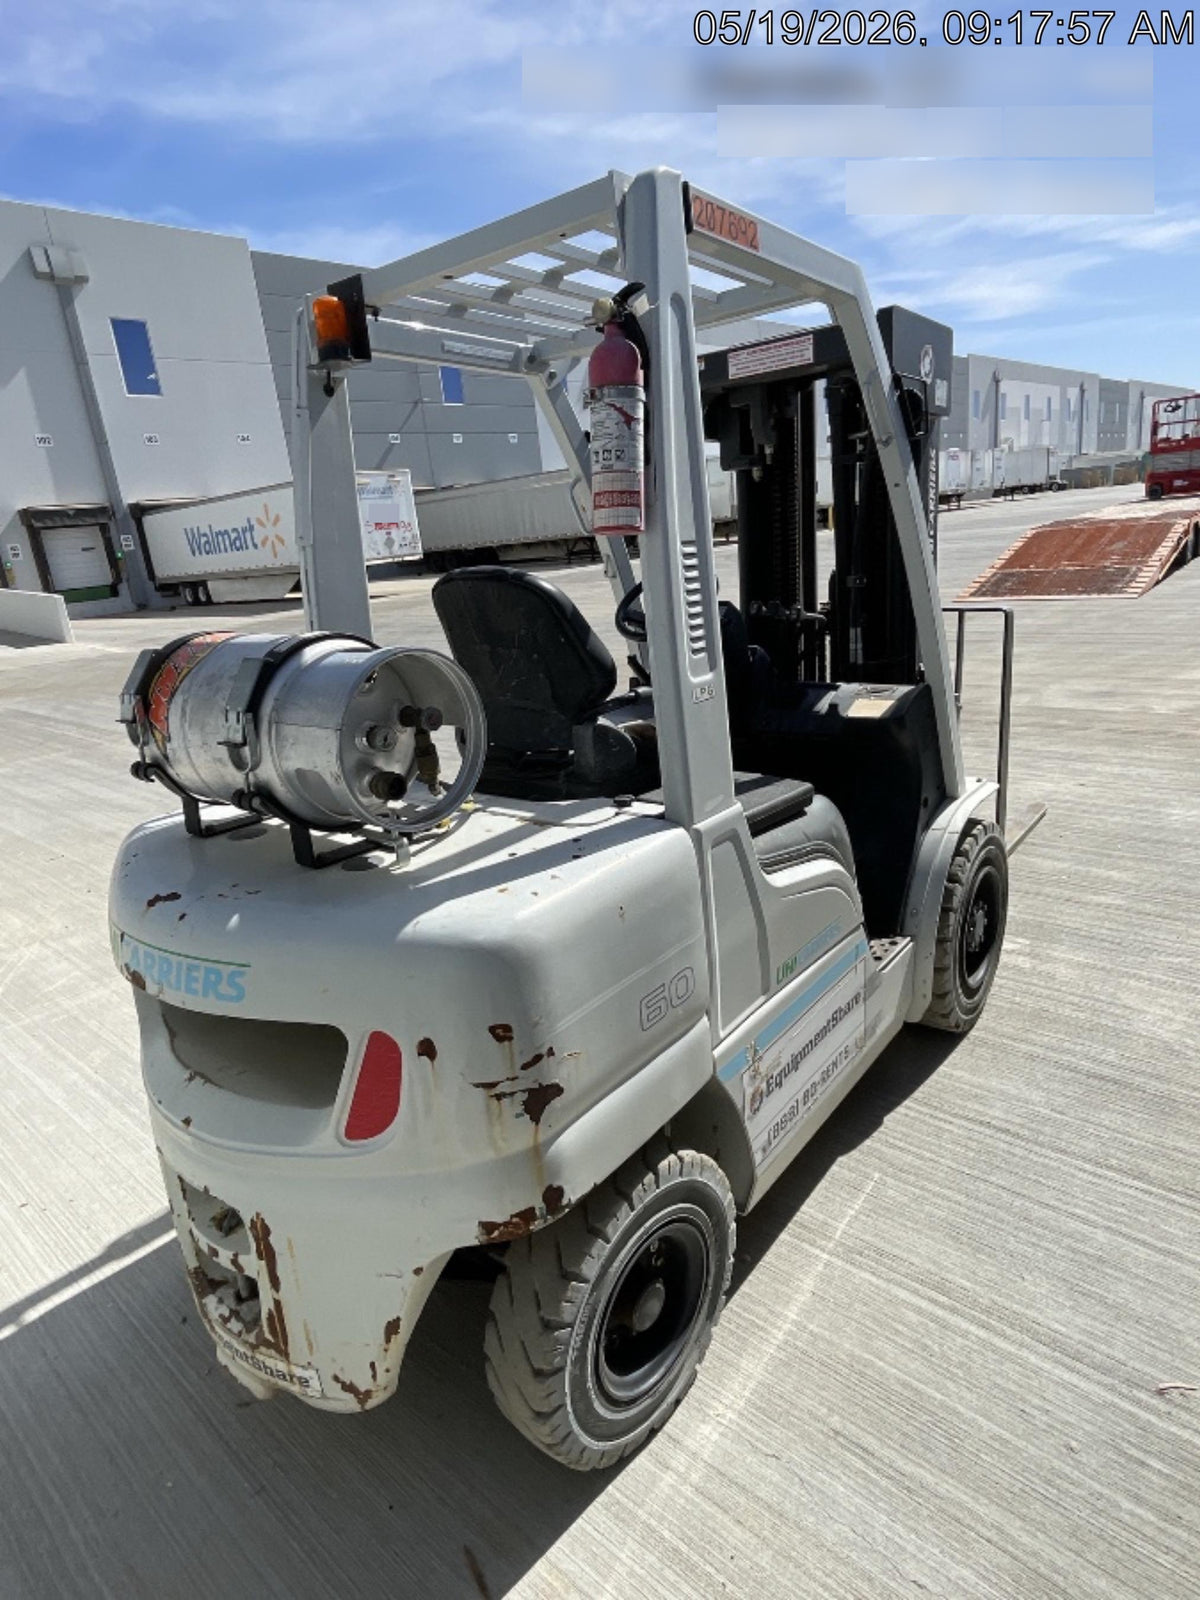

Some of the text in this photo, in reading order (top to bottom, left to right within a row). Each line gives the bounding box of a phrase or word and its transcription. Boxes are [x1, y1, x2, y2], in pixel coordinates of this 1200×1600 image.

[183, 517, 258, 557] Walmart
[122, 938, 247, 1003] ARRIERS
[639, 966, 696, 1031] 60
[765, 991, 862, 1098] EquipmentShare
